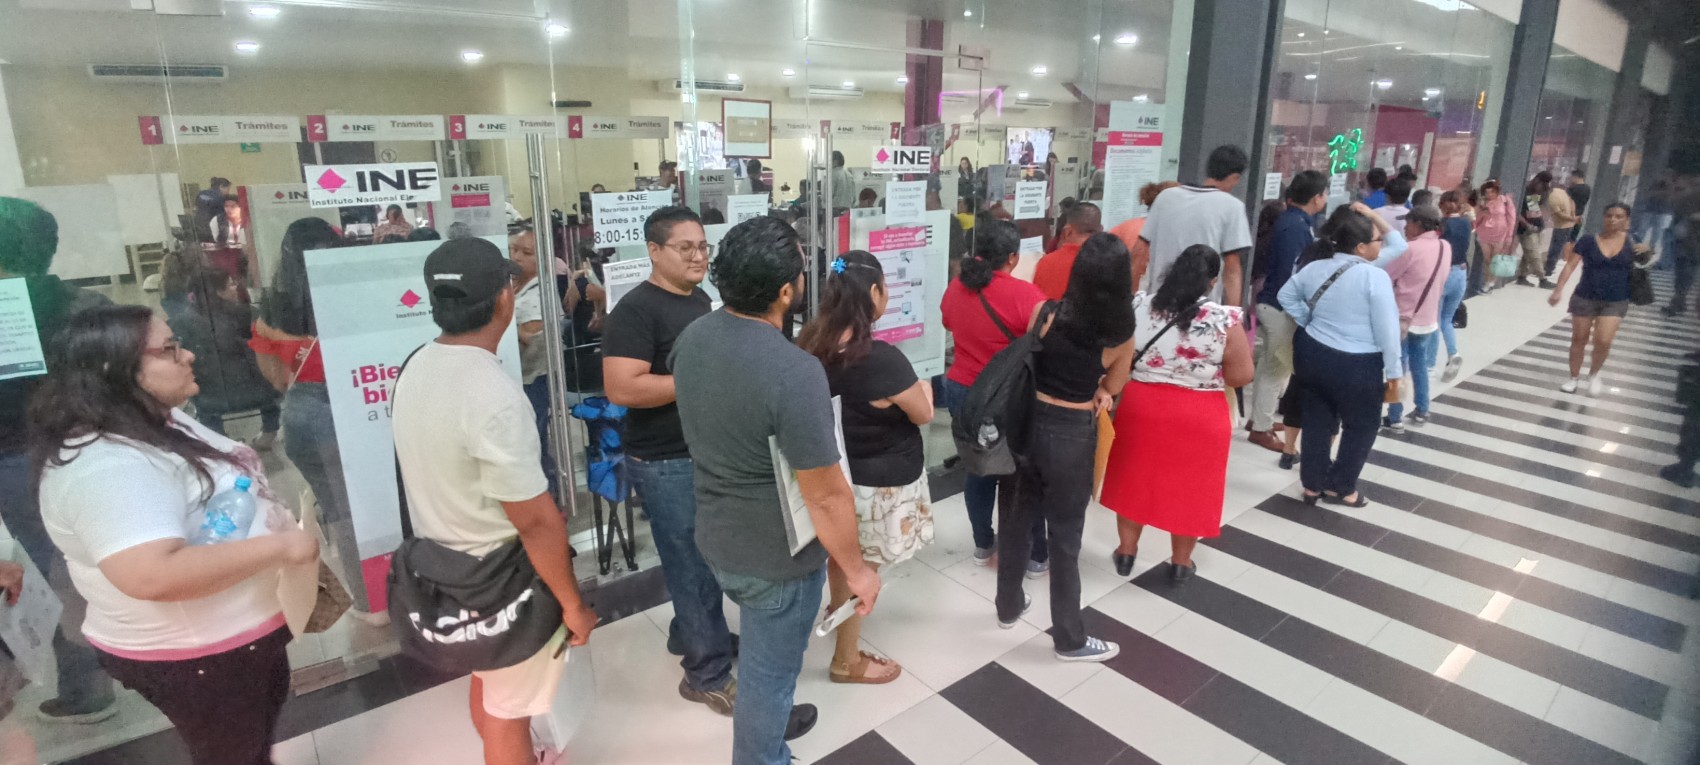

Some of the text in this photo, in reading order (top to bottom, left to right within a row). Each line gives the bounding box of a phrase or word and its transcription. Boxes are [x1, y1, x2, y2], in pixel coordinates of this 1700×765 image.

[234, 121, 289, 131] Trámites
[390, 120, 434, 129] Trámites
[628, 120, 662, 128] Trámites
[1143, 117, 1160, 126] INE
[147, 124, 157, 136] 1
[191, 125, 220, 133] INE
[314, 123, 325, 134] 2
[454, 123, 463, 133] 3
[572, 123, 580, 132] 4
[893, 150, 930, 165] INE
[356, 168, 438, 193] INE
[706, 175, 725, 183] INE
[463, 183, 490, 192] INE
[288, 191, 308, 199] IN
[312, 198, 354, 206] Instituto
[356, 193, 398, 204] Nacional
[626, 193, 648, 201] INE
[600, 206, 629, 214] Horarios
[600, 217, 629, 226] Lunes
[350, 363, 401, 388] ¡Bie
[367, 410, 379, 421] a
